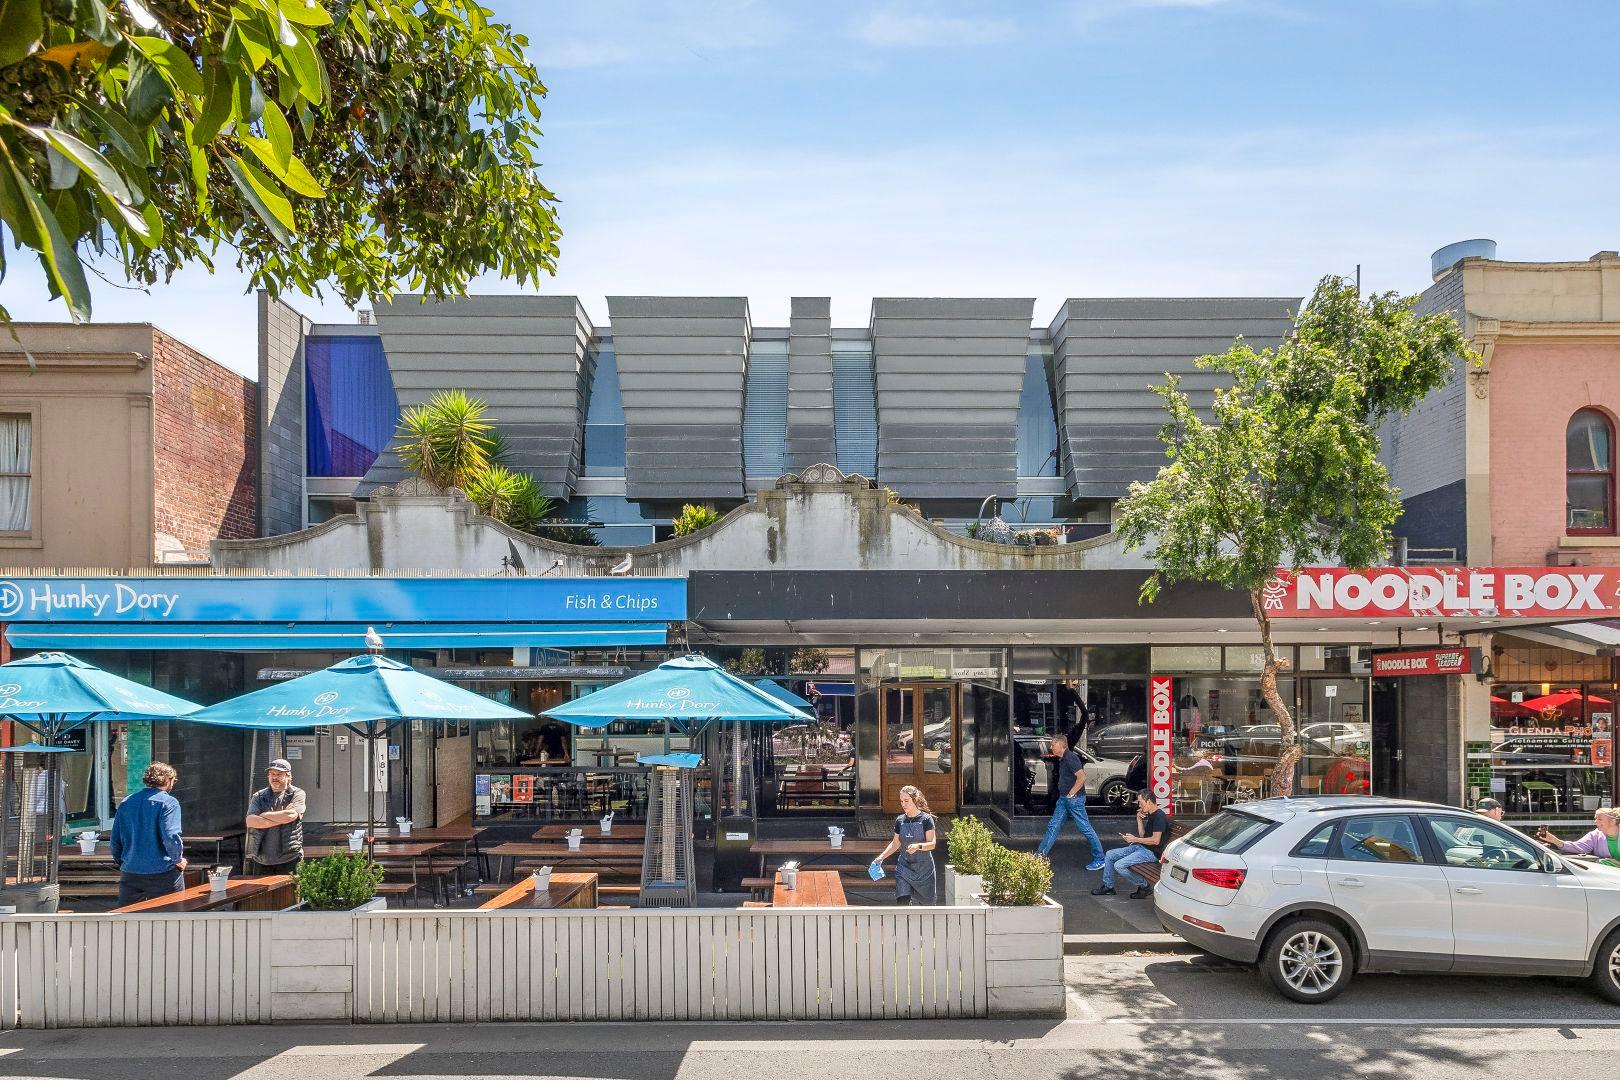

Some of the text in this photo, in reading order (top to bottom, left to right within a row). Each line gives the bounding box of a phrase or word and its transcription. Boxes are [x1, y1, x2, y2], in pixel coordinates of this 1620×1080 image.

[1297, 573, 1606, 611] NOODLE BOX
[30, 583, 179, 617] Hunky Dory
[565, 594, 658, 612] Fish & Chips
[1381, 657, 1428, 671] NOODLE BOX
[0, 697, 48, 709] Dory
[626, 699, 721, 712] Hunky Dory
[266, 704, 355, 719] Hunky Dory
[1508, 725, 1562, 736] GLENDA
[1564, 725, 1592, 737] PHO
[1152, 679, 1170, 815] NOODLE BOX
